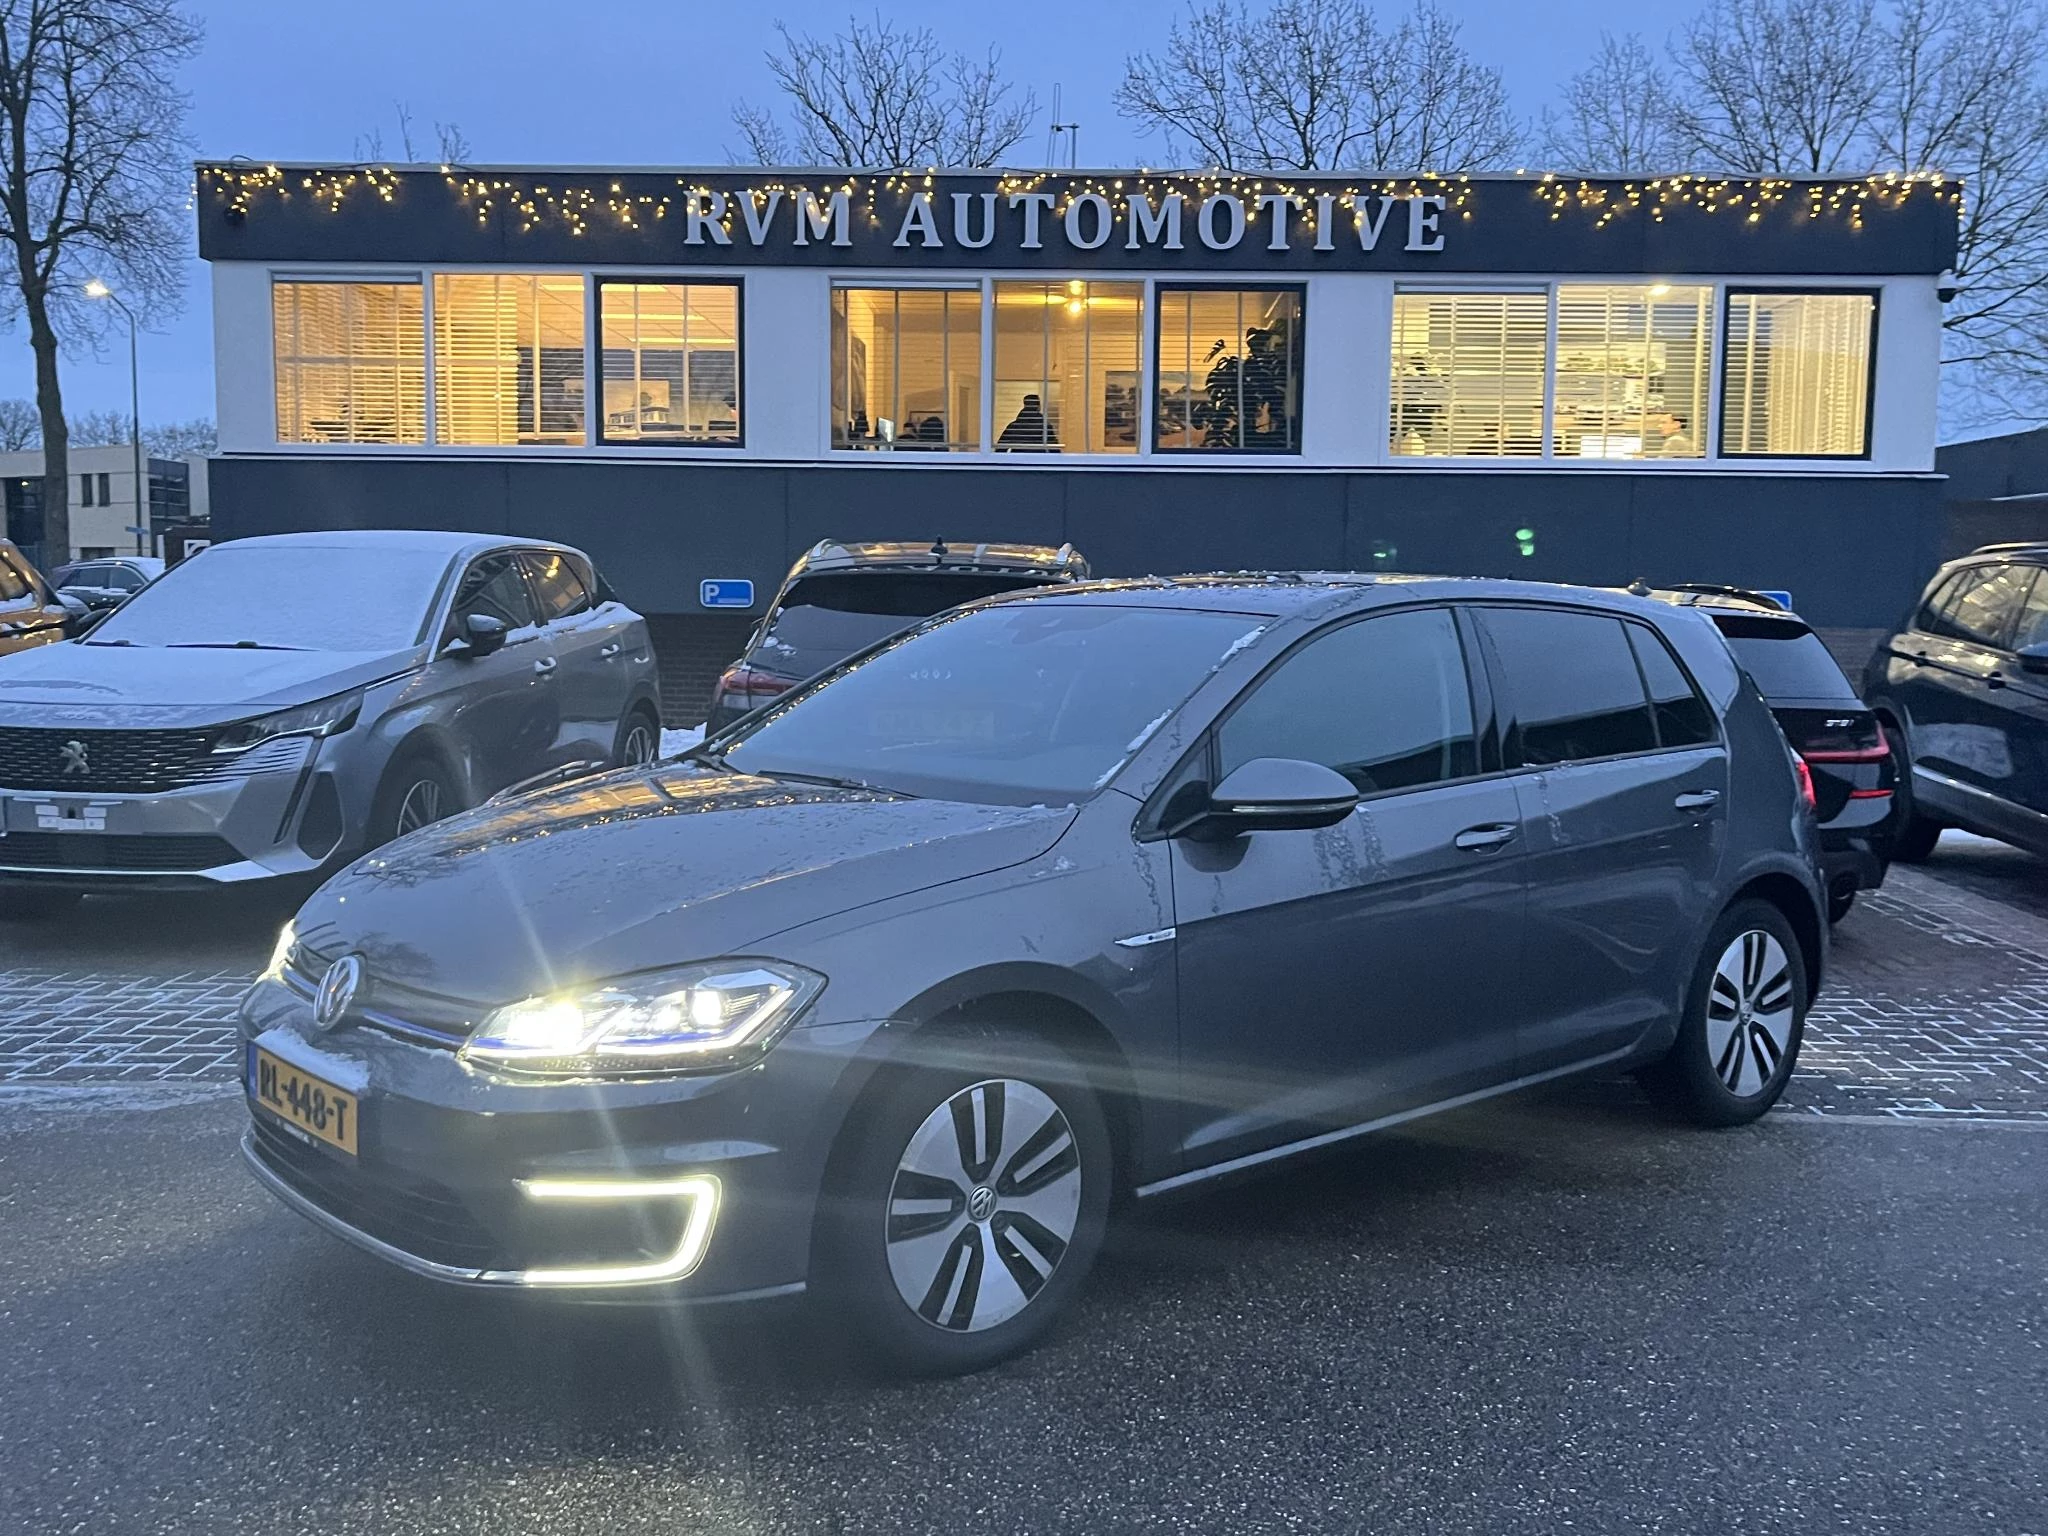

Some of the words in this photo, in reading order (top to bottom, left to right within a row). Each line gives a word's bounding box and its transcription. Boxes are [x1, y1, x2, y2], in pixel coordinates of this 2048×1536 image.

[683, 190, 853, 246] RVM
[892, 192, 1447, 251] AUTOMOTIVE
[704, 584, 720, 603] P
[259, 1058, 348, 1141] RL-448-T
